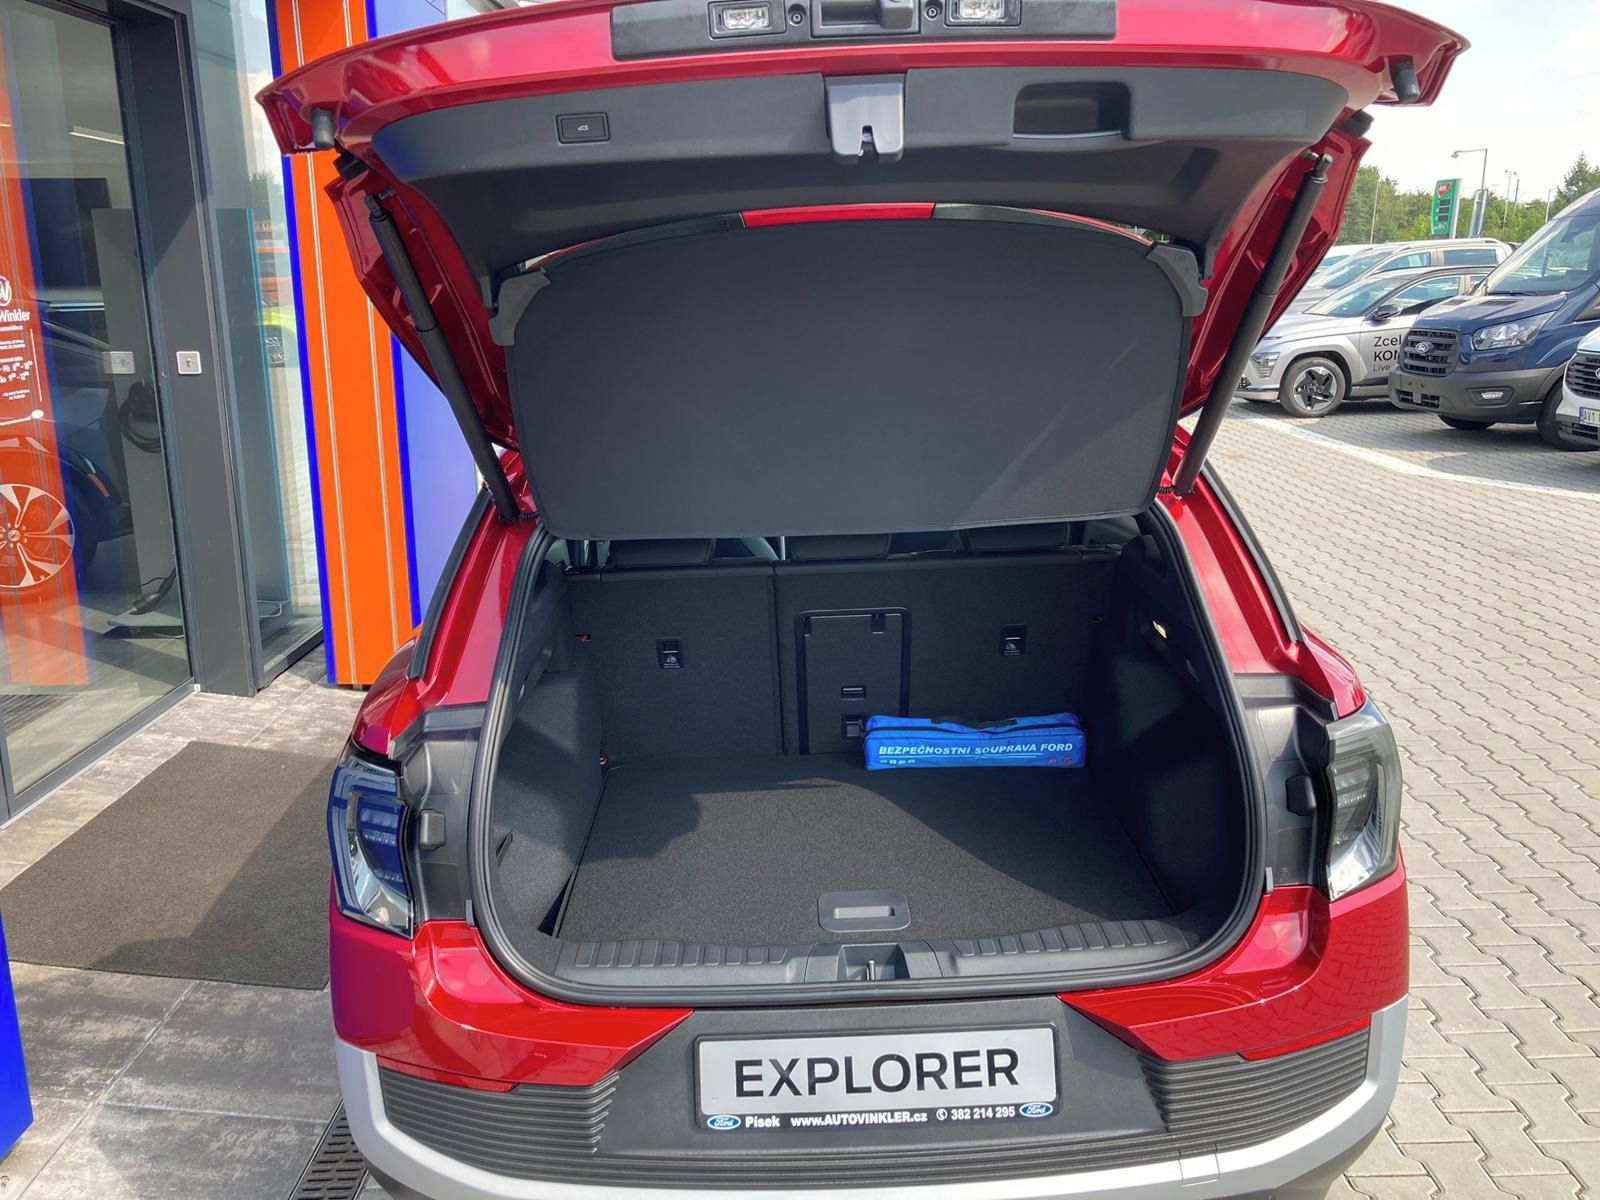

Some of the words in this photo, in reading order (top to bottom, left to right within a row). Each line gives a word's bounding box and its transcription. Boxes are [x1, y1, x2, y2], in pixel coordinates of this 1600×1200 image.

[879, 744, 970, 755] BEZPEČNOSTNÍ
[974, 743, 1037, 754] SOUPRAVA
[1040, 743, 1073, 752] FORD
[735, 1048, 1019, 1098] EXPLORER
[710, 1116, 737, 1129] Ford
[745, 1115, 780, 1128] Písek
[790, 1111, 928, 1128] www.AUTOVINKLER.cz
[951, 1108, 971, 1120] 382
[973, 1107, 993, 1119] 214
[995, 1106, 1016, 1118] 295
[1022, 1103, 1049, 1116] Ford
